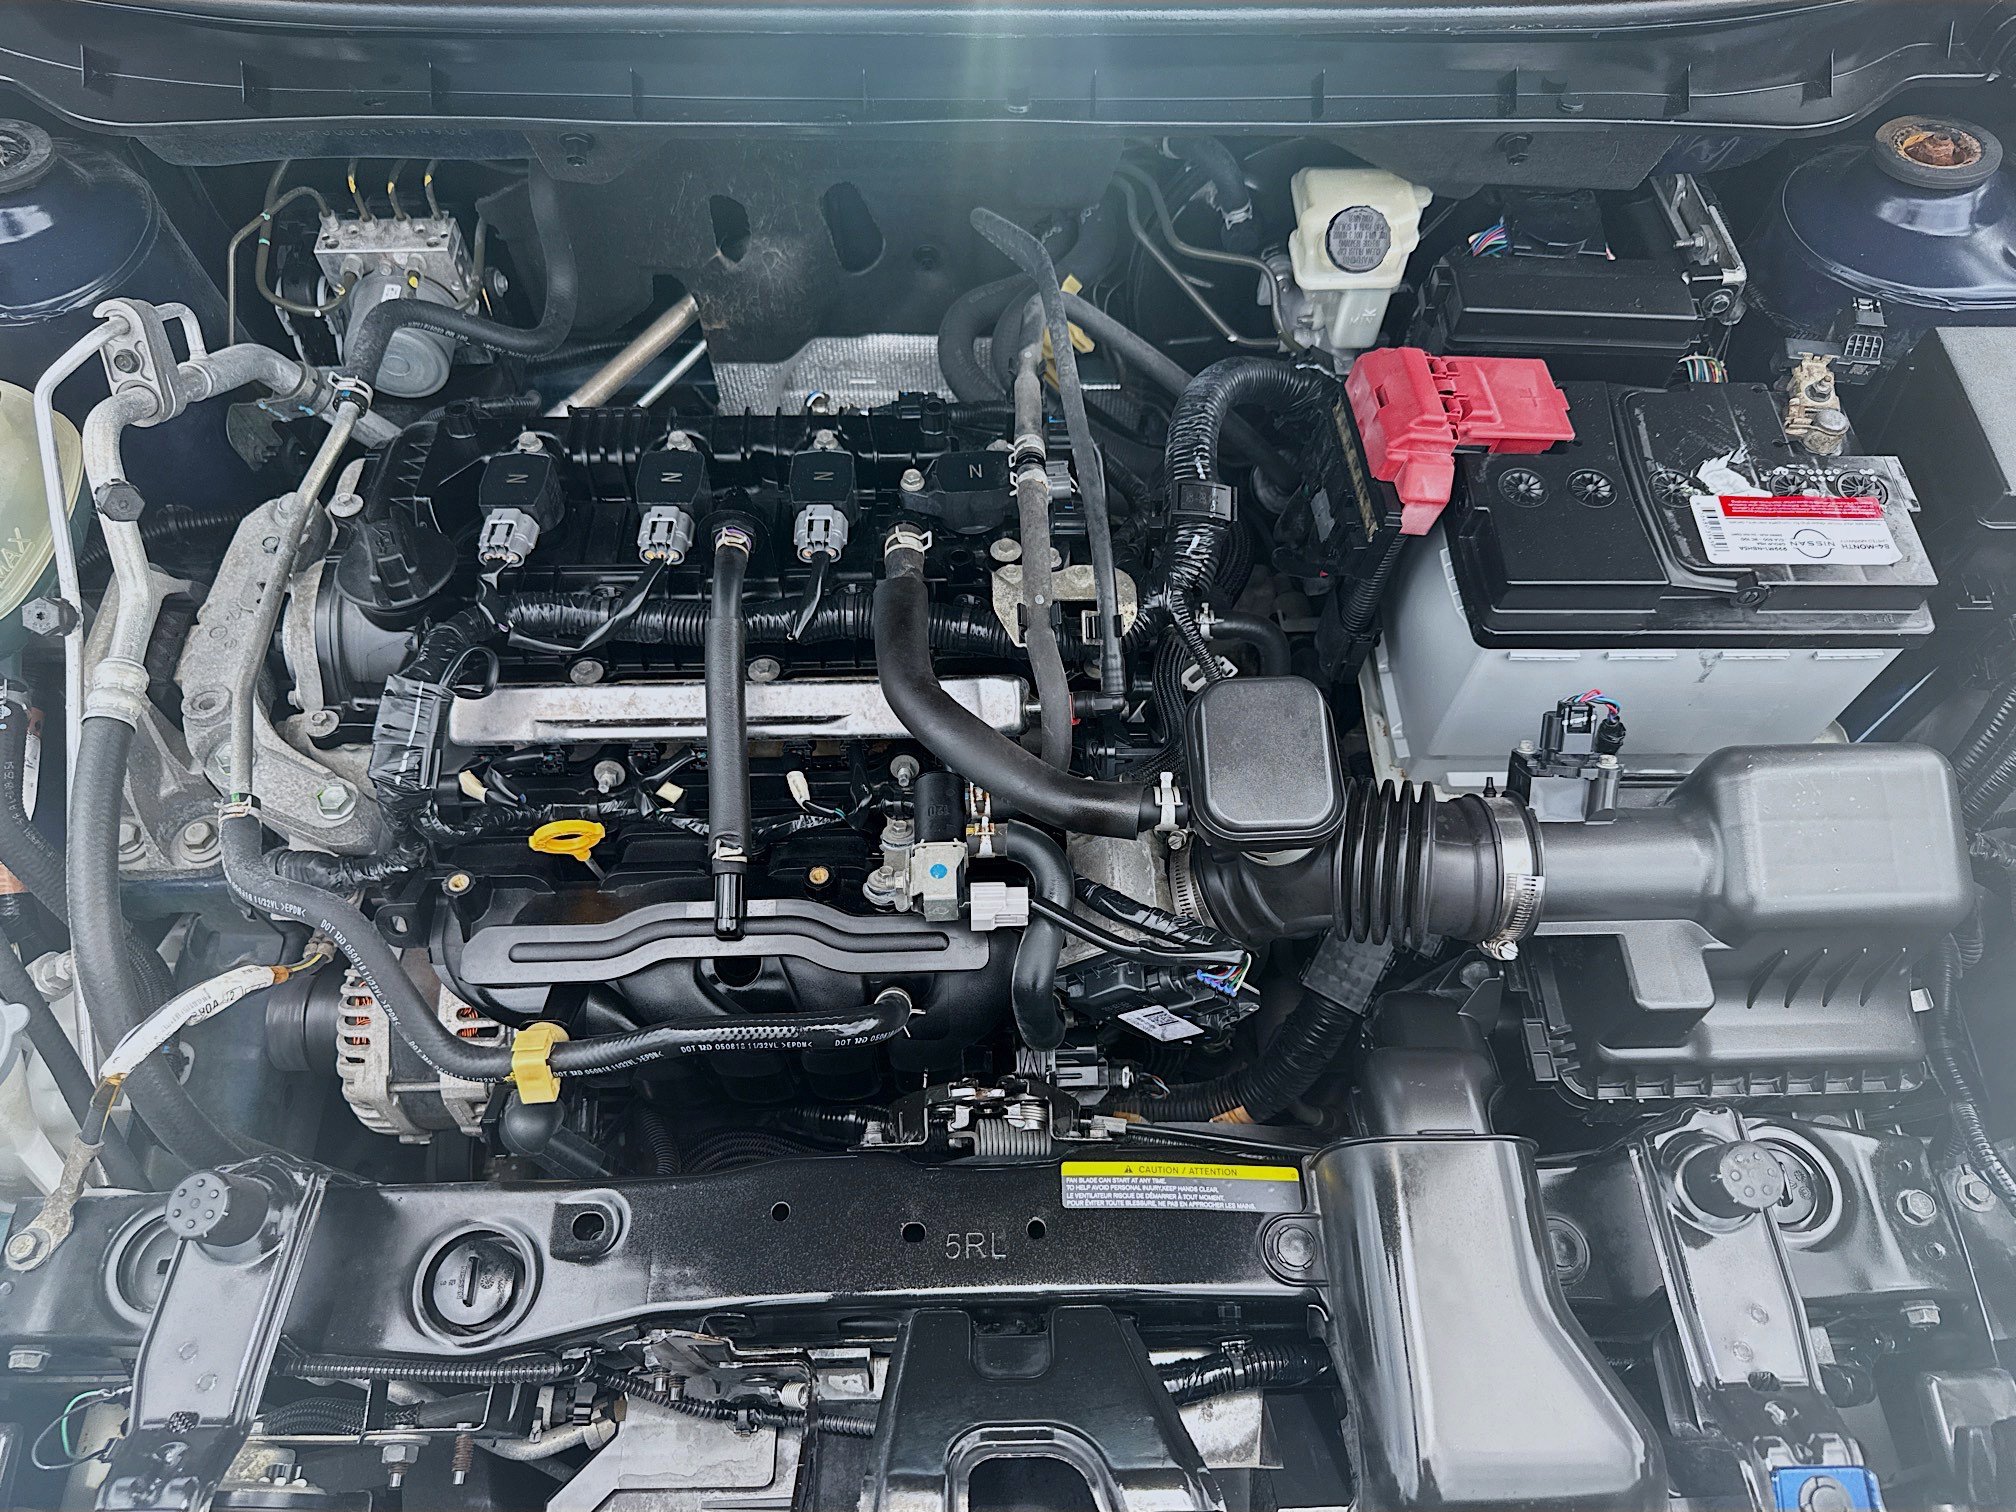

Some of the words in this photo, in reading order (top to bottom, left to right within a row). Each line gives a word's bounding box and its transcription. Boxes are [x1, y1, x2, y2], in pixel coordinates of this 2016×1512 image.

[968, 464, 983, 479] N
[320, 919, 335, 934] DOT
[408, 1040, 422, 1054] DOT
[680, 1045, 696, 1053] DOT
[834, 1038, 852, 1047] DOT
[1138, 1165, 1179, 1174] CAUTION
[1189, 1167, 1238, 1176] ATTENTION
[945, 1232, 1006, 1259] 5RL
